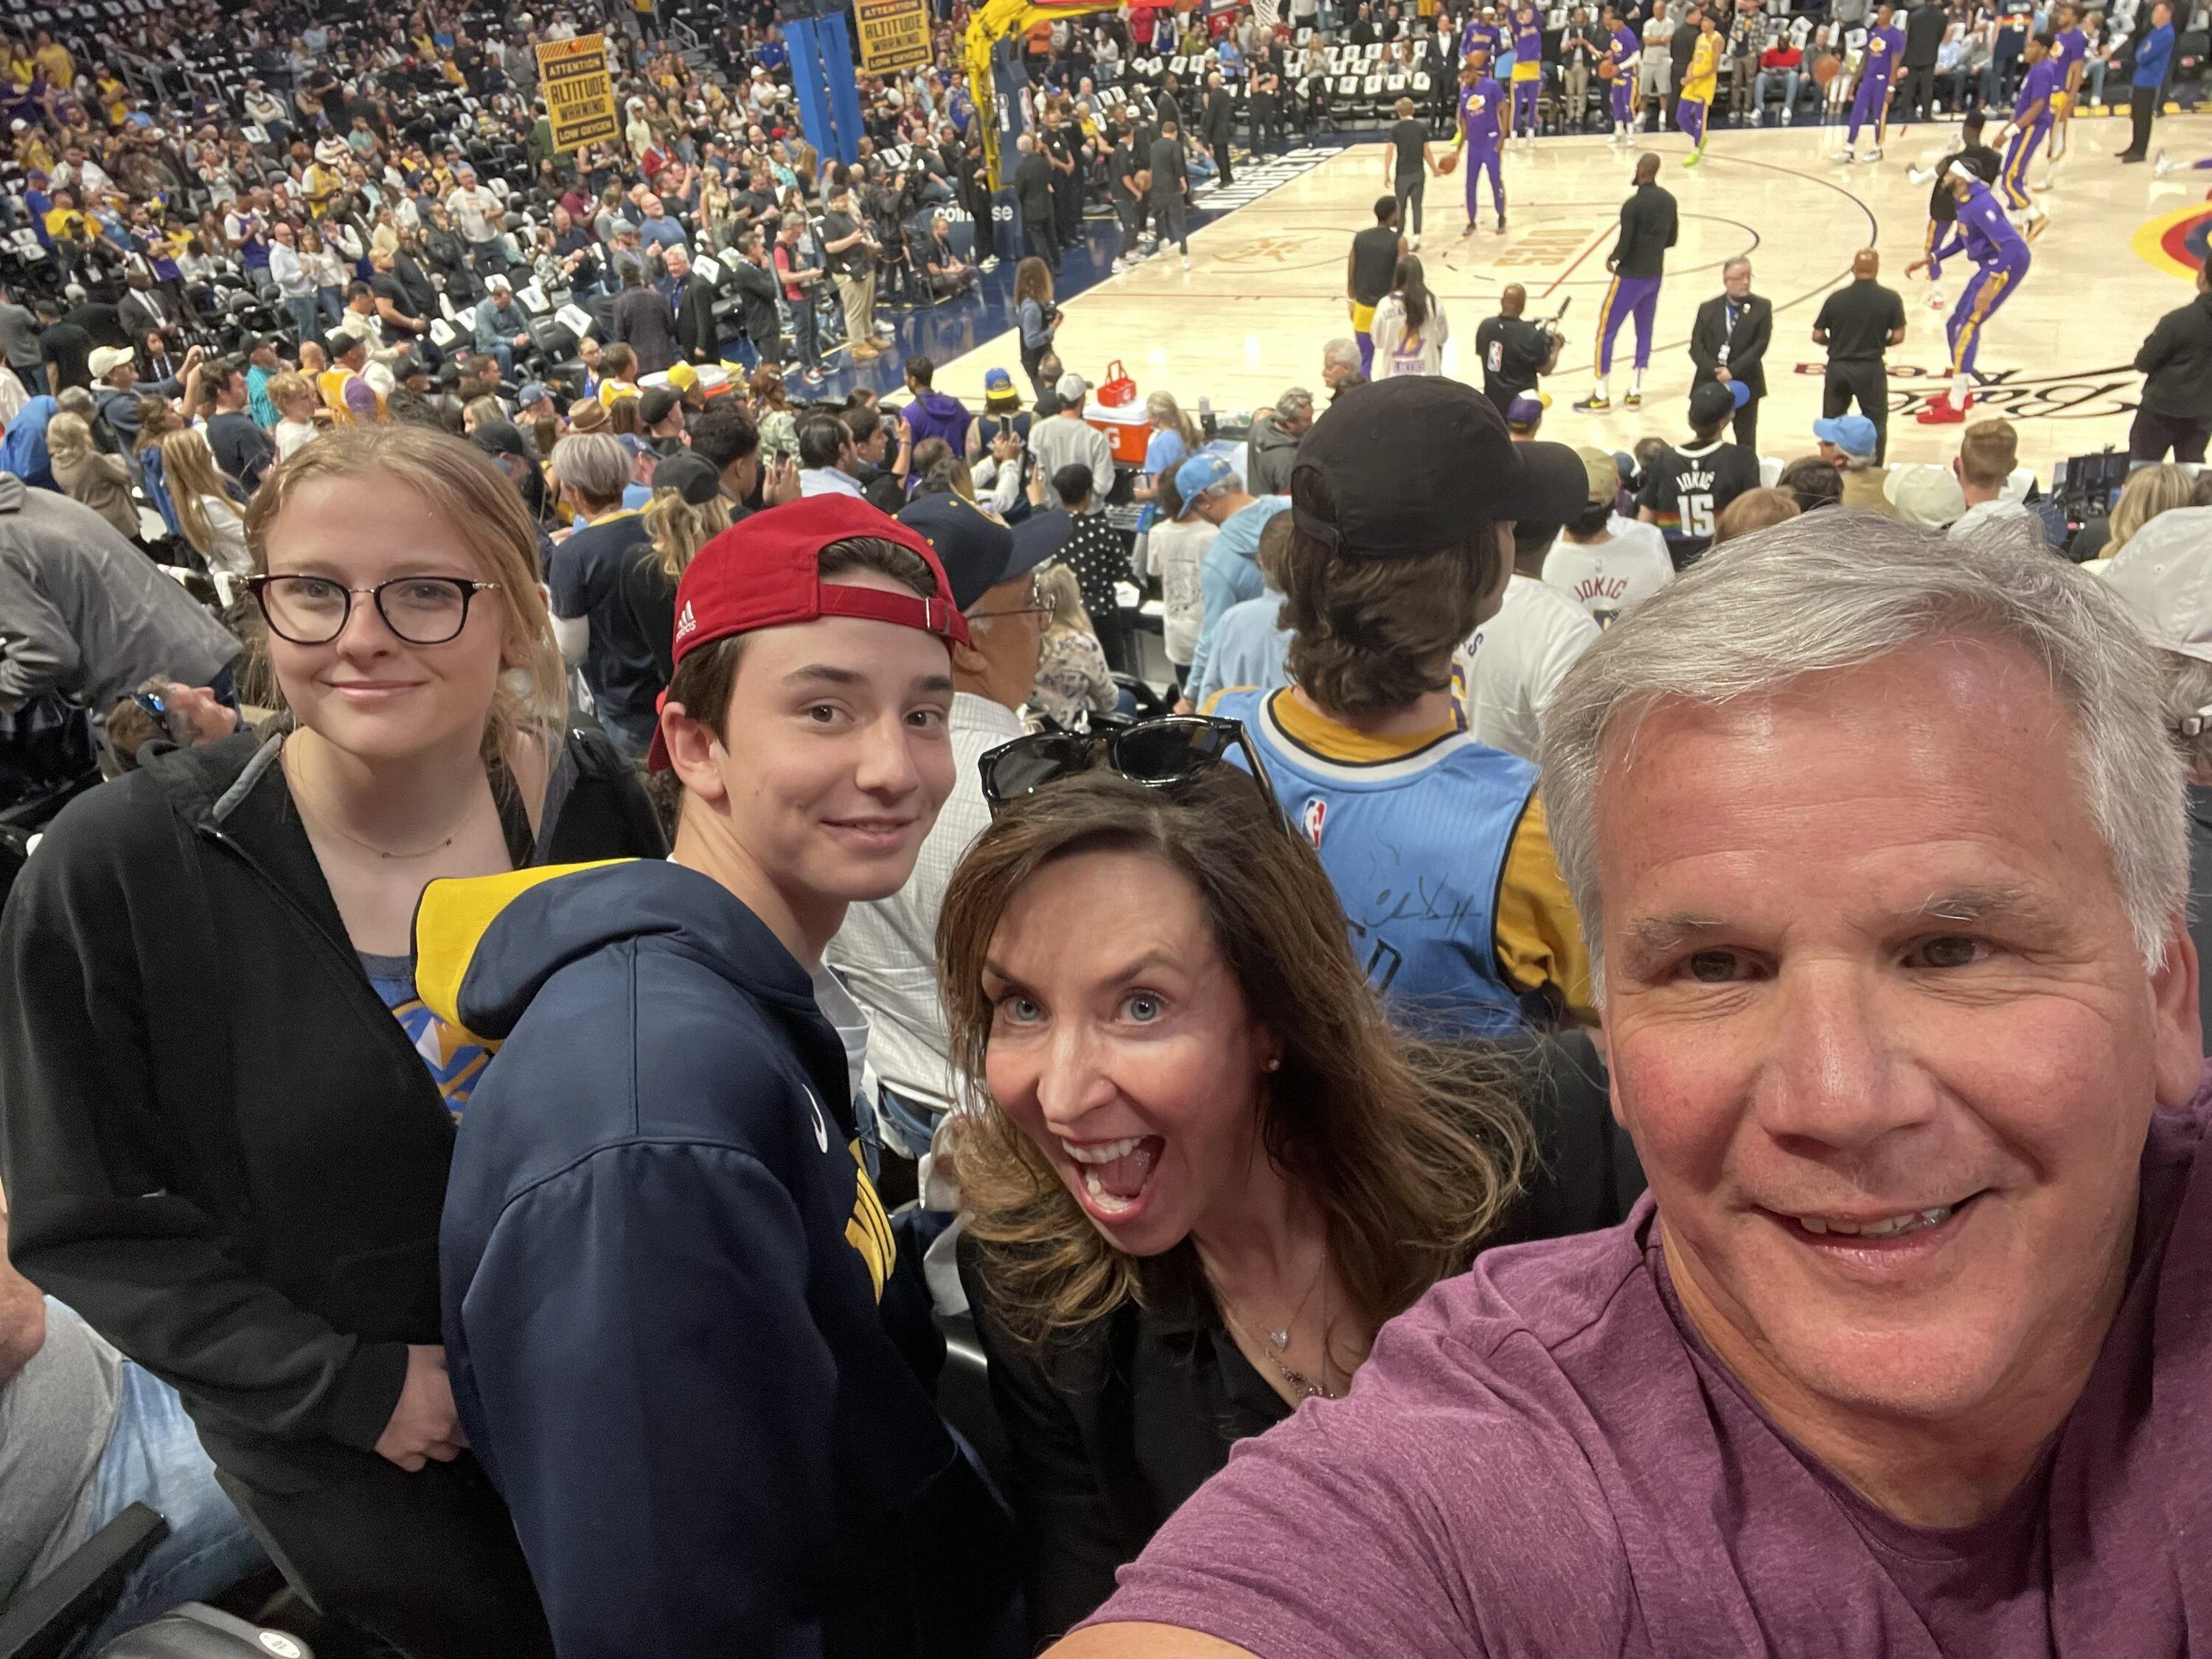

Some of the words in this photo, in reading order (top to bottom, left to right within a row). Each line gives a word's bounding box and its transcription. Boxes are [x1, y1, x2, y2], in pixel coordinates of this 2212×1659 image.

[865, 13, 922, 40] ALTITUDE
[550, 75, 608, 105] ALTITUDE
[1677, 493, 1716, 537] 15
